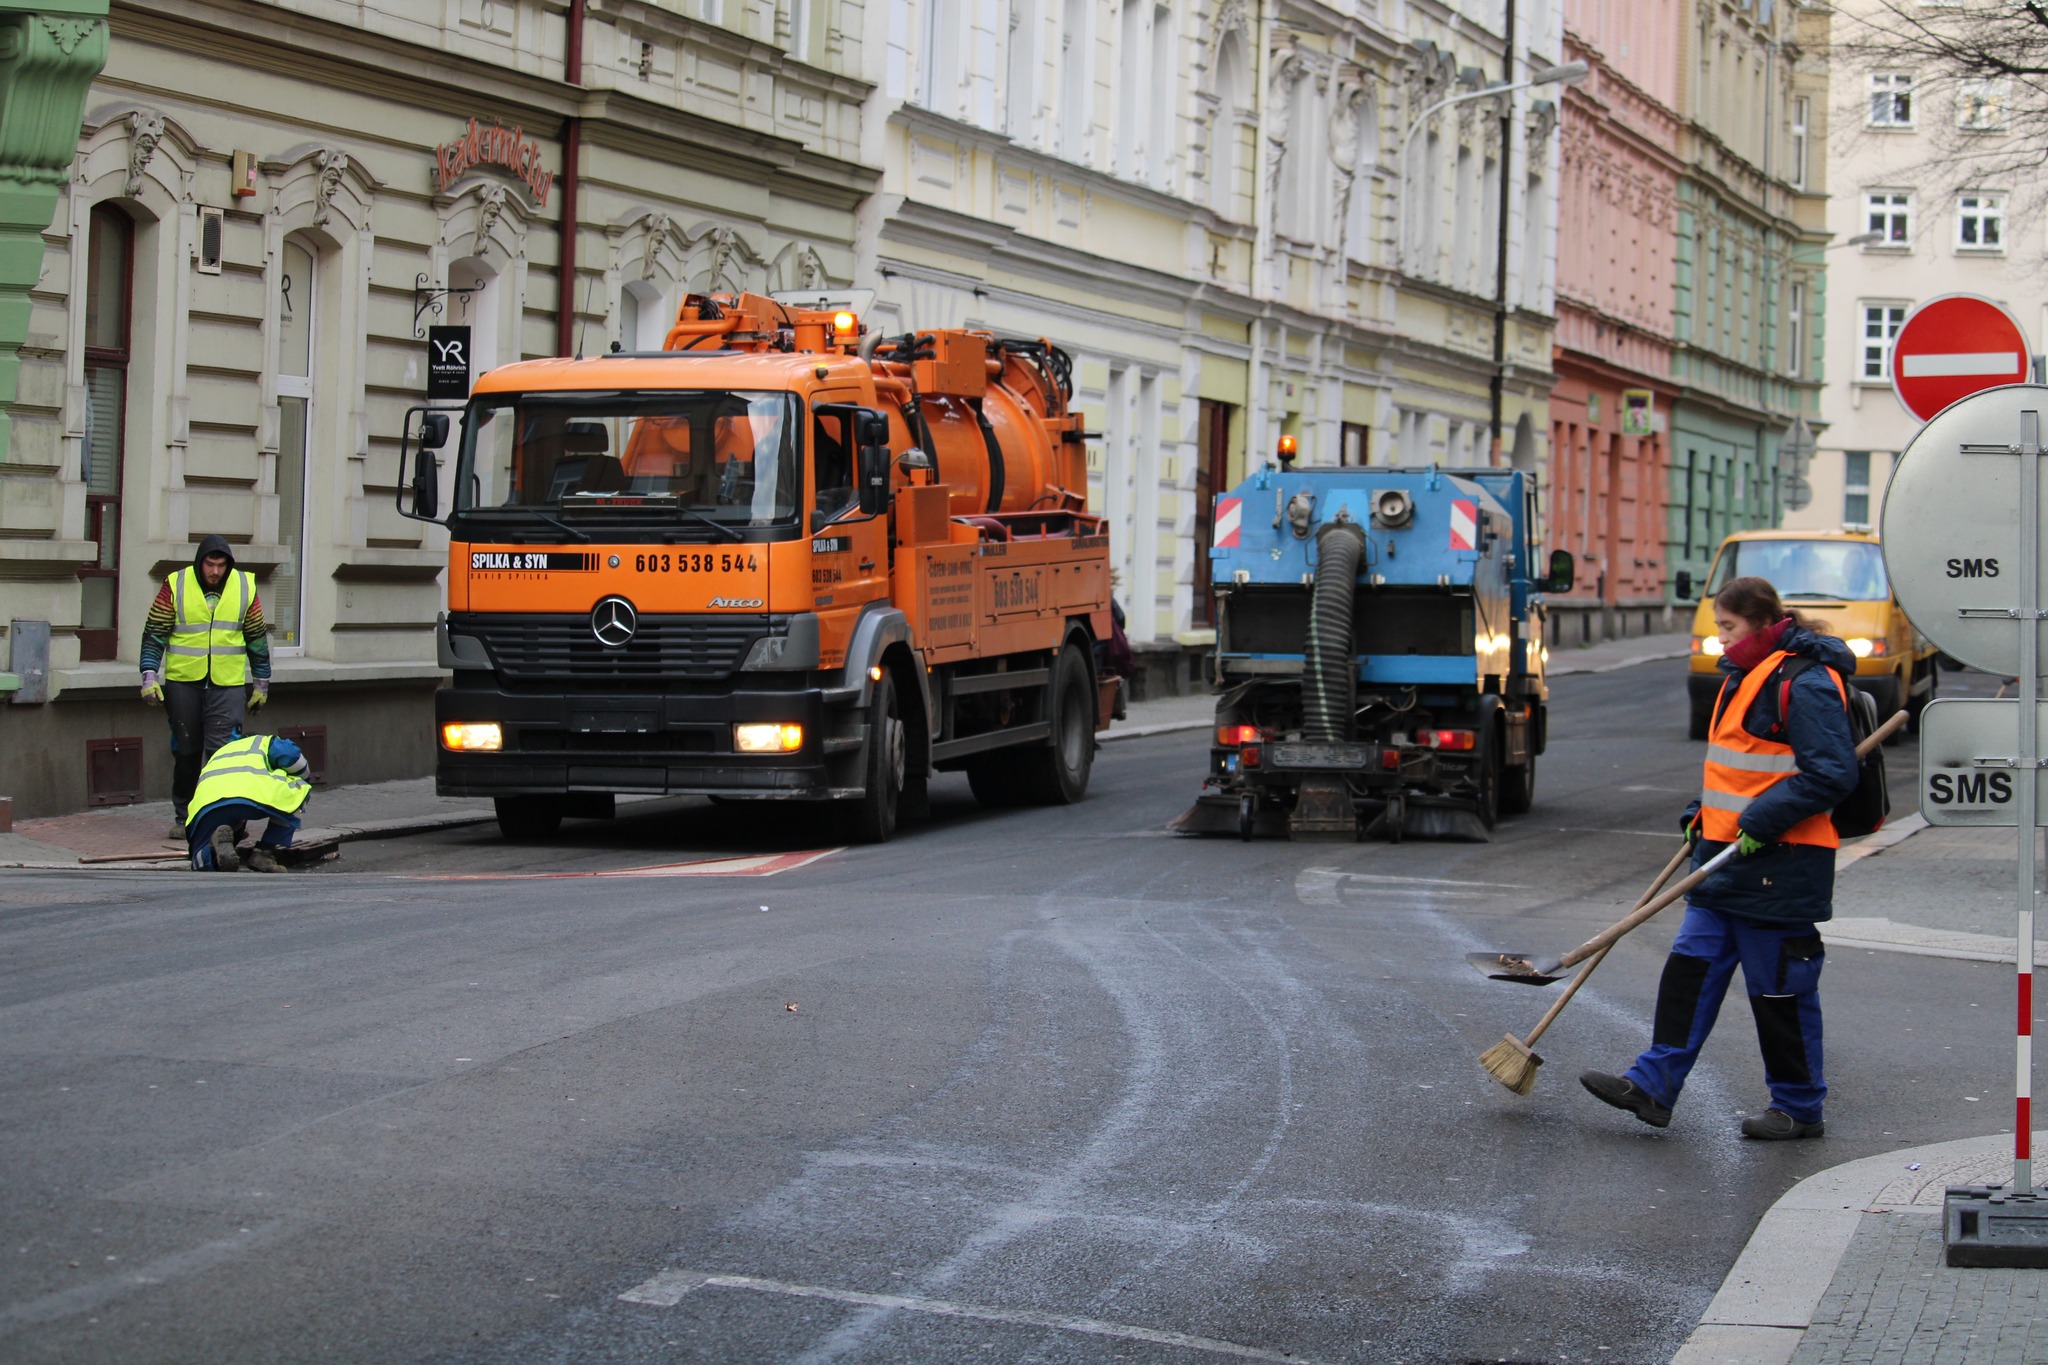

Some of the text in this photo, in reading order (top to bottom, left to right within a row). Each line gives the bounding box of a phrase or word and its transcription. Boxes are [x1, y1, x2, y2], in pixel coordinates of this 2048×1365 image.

[433, 339, 467, 365] YR
[812, 539, 826, 553] SPILKA
[830, 538, 839, 551] SYN
[472, 553, 548, 569] SPILKA & SYN
[635, 554, 757, 573] 603 538 544
[1946, 558, 2000, 579] SMS
[812, 569, 822, 583] 603
[823, 569, 832, 583] 538
[994, 580, 1008, 609] 603
[1010, 578, 1023, 606] 538
[1025, 577, 1039, 605] 544
[1929, 772, 2012, 804] SMS
